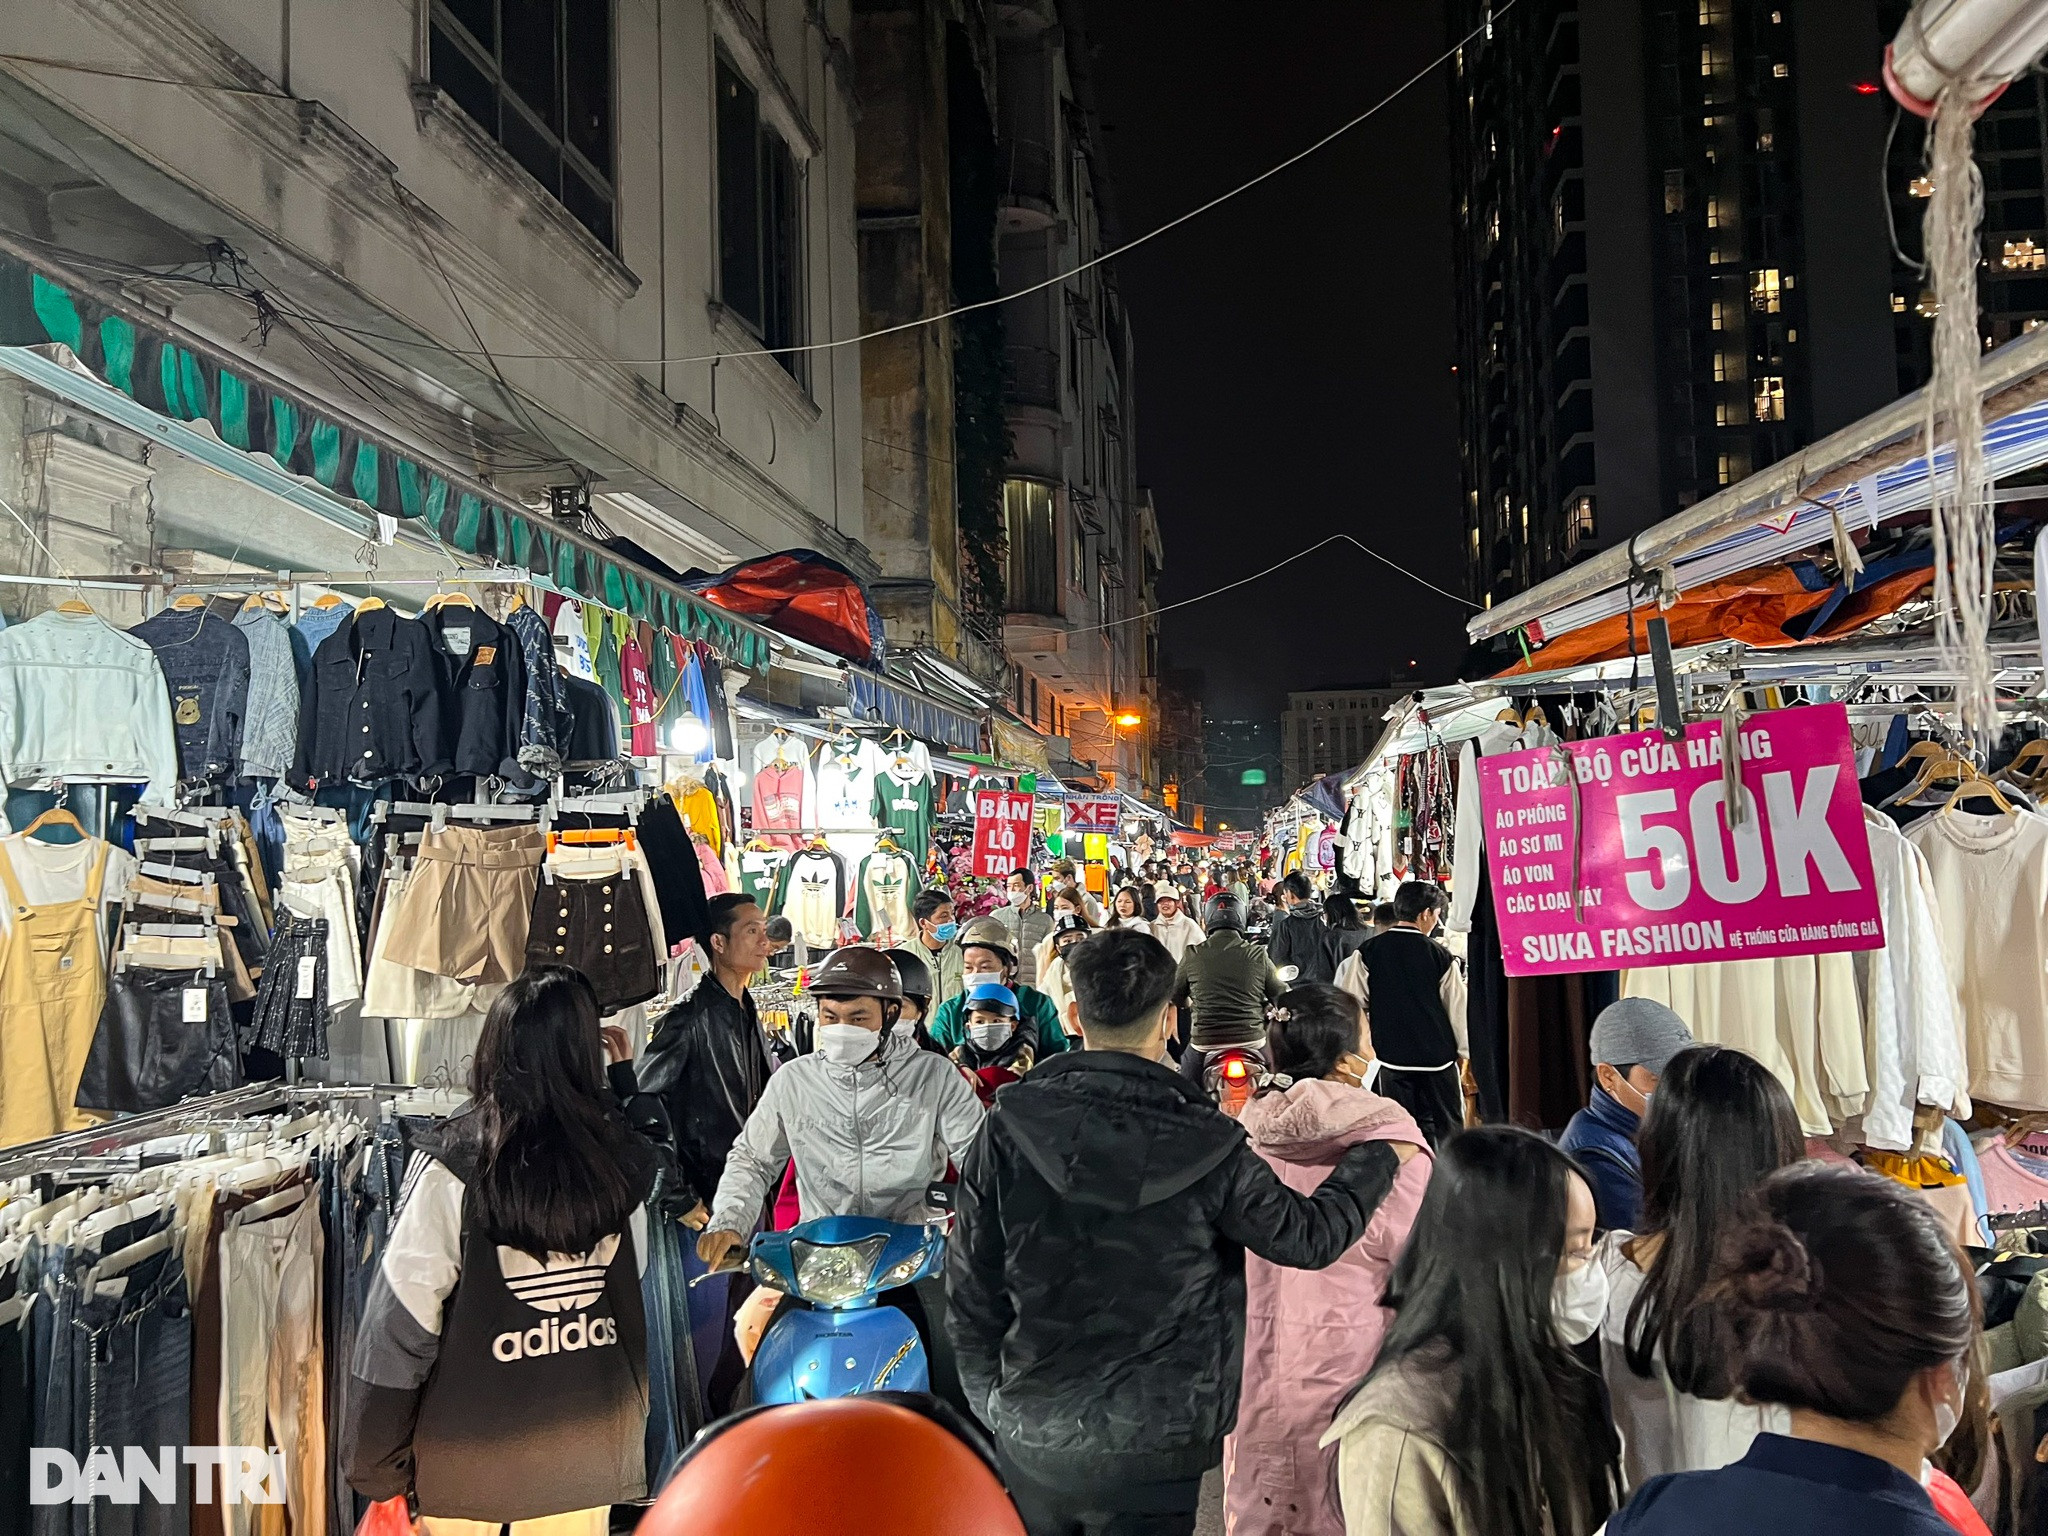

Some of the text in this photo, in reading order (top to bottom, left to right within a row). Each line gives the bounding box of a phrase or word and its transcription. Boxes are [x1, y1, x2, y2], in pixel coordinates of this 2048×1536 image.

[1498, 758, 1568, 795] TOÀN
[1573, 748, 1613, 787] BỘ
[1620, 737, 1680, 778] CỬA
[980, 793, 1030, 822] BẮN
[1066, 803, 1118, 826] XE
[1496, 803, 1567, 829] ÁO PHÔNG
[988, 823, 1015, 850] LỖ
[1499, 833, 1563, 857] ÁO SƠ MI
[1616, 764, 1862, 911] 50K
[984, 854, 1017, 875] TAI
[1503, 863, 1554, 885] ÁO VON
[1506, 892, 1535, 914] CÁC
[1538, 891, 1571, 913] LOẠI
[1523, 920, 1725, 964] SUKA FASHION
[1729, 930, 1743, 949] HỆ
[1744, 926, 1777, 947] THỐNG
[1778, 923, 1799, 943] CỬA
[1800, 923, 1829, 941] HÀNG
[1860, 917, 1879, 936] GIÁ
[492, 1313, 617, 1362] adidas
